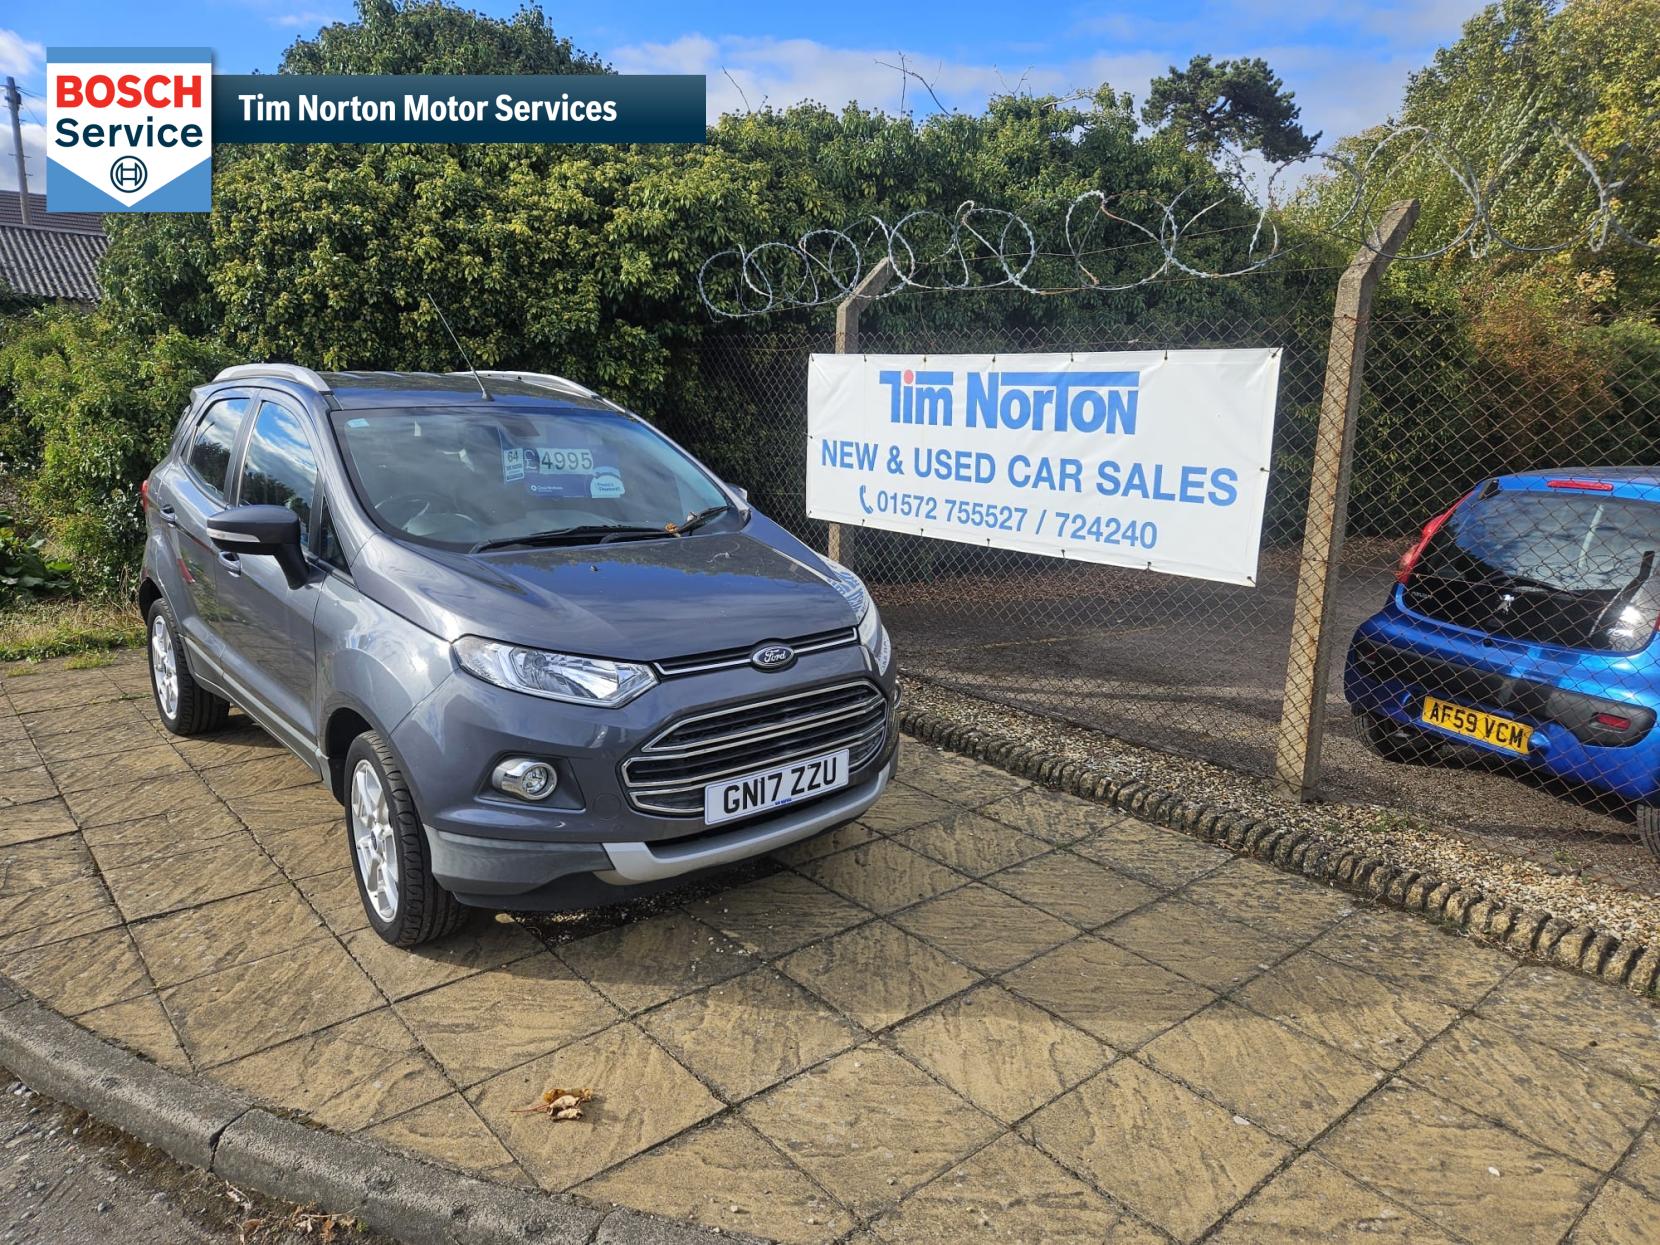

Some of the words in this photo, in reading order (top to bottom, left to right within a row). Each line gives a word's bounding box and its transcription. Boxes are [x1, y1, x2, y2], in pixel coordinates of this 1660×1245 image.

[879, 369, 954, 427] Tim
[821, 439, 878, 471] NEW
[886, 445, 903, 475] &
[913, 447, 996, 484] USED
[1007, 454, 1083, 492] CAR
[1095, 460, 1238, 507] SALES
[877, 490, 937, 520] 01572
[944, 499, 1028, 532] 755527
[1035, 509, 1048, 534] /
[1055, 511, 1158, 549] 724240
[764, 649, 787, 663] Ford
[1428, 703, 1478, 734] AF59
[1484, 717, 1524, 748] VCM
[723, 771, 783, 814] GN17
[790, 757, 837, 796] ZZU
